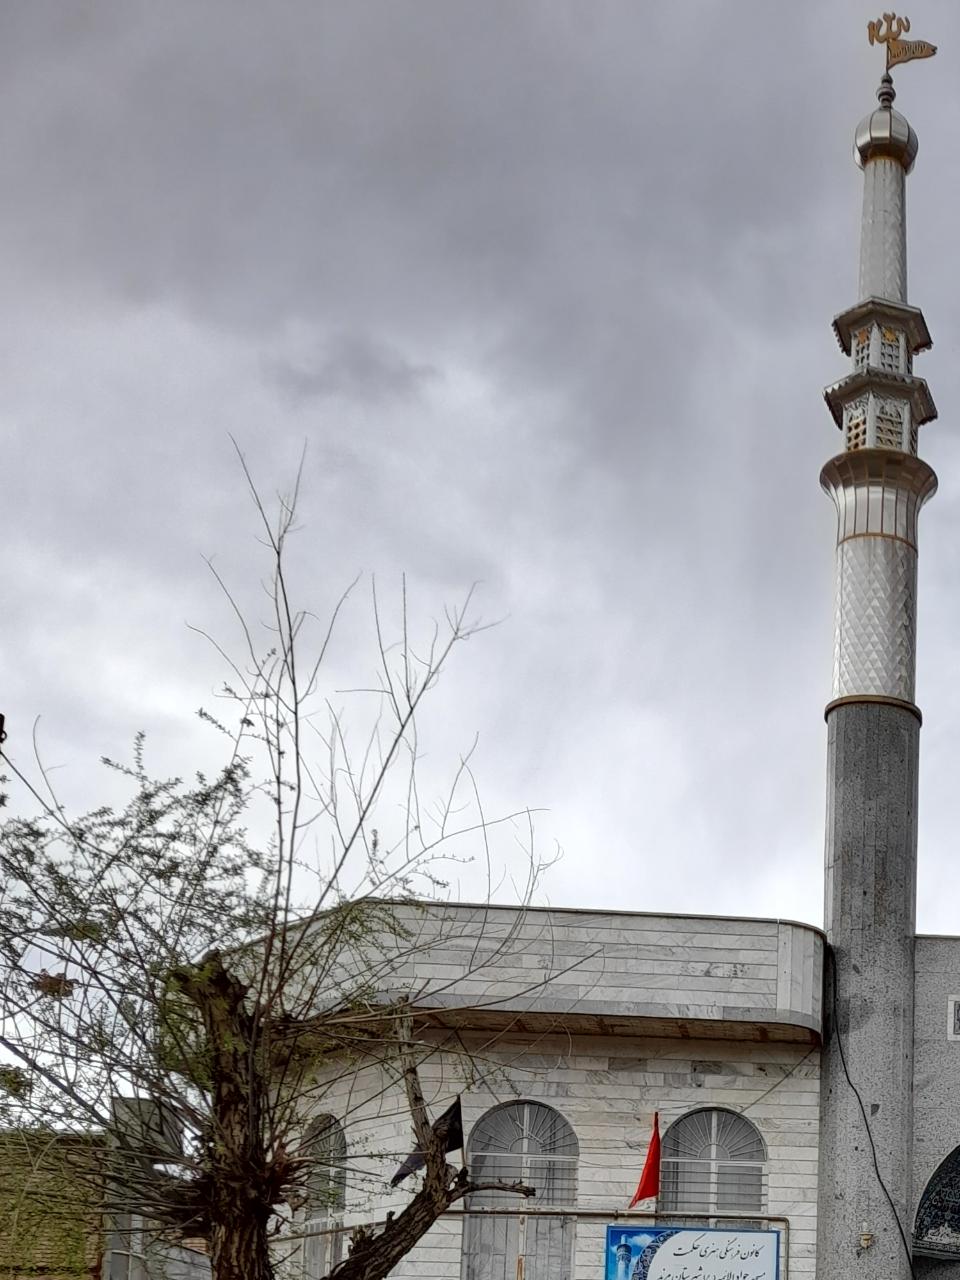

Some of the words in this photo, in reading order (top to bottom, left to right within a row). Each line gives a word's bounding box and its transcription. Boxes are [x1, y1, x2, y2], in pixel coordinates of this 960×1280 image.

[673, 1232, 707, 1256] حکمت
[699, 1242, 720, 1258] هنری
[719, 1237, 741, 1260] فرهنگی
[740, 1243, 765, 1260] کانون
